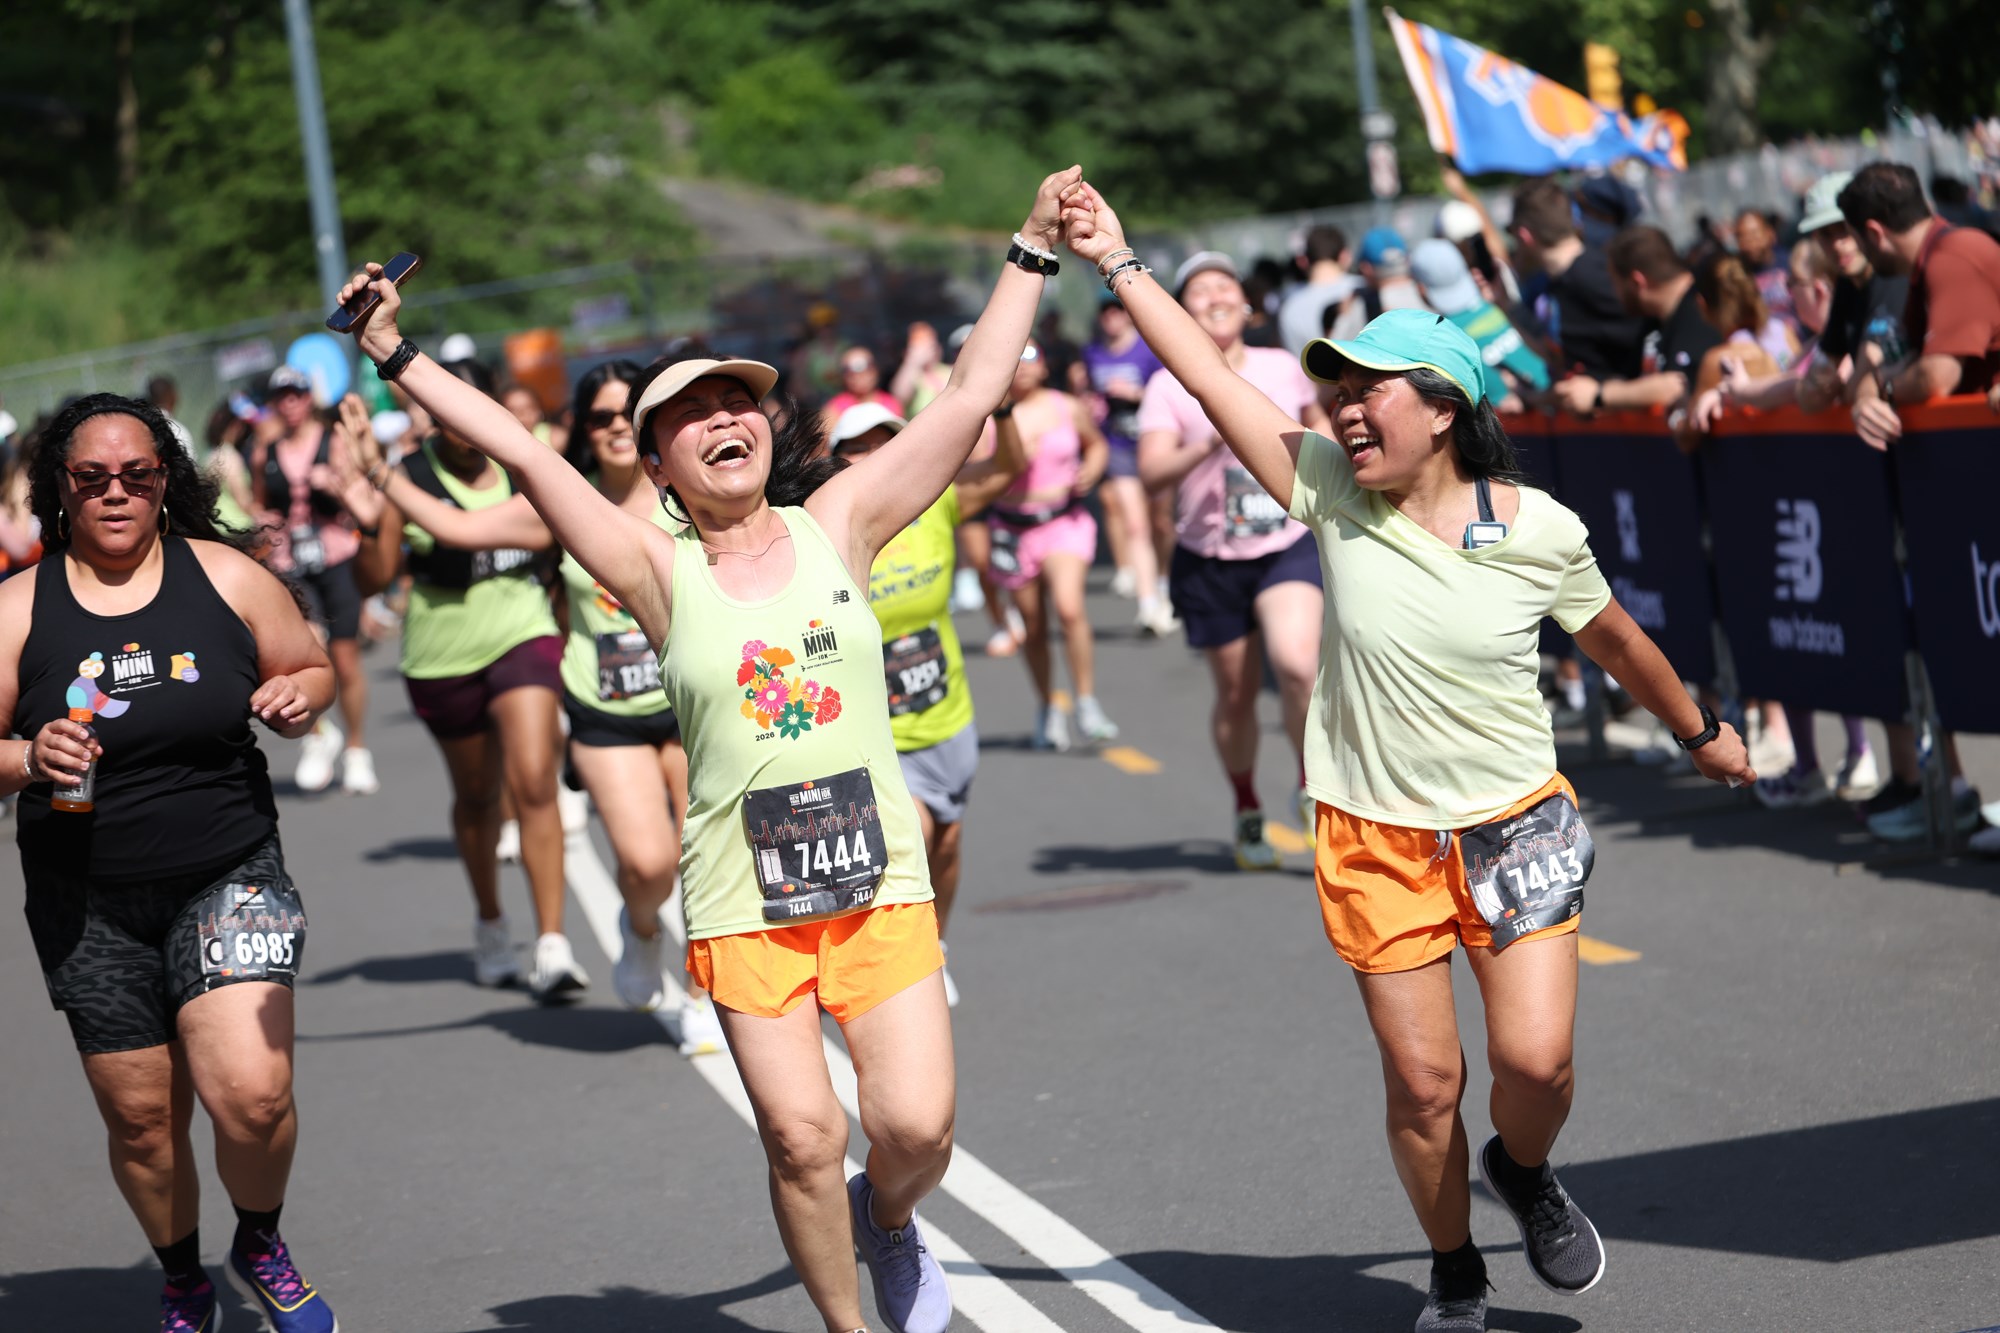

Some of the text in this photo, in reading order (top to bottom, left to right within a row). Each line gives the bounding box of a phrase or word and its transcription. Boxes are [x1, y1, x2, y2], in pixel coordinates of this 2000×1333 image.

[803, 631, 838, 658] MINI
[112, 655, 155, 682] MINI
[799, 788, 822, 805] MINI
[794, 829, 871, 879] 7444
[1507, 847, 1584, 899] 7443
[788, 901, 813, 916] 7444
[852, 888, 873, 904] 7444
[1513, 917, 1538, 936] 7443
[235, 932, 295, 965] 6985
